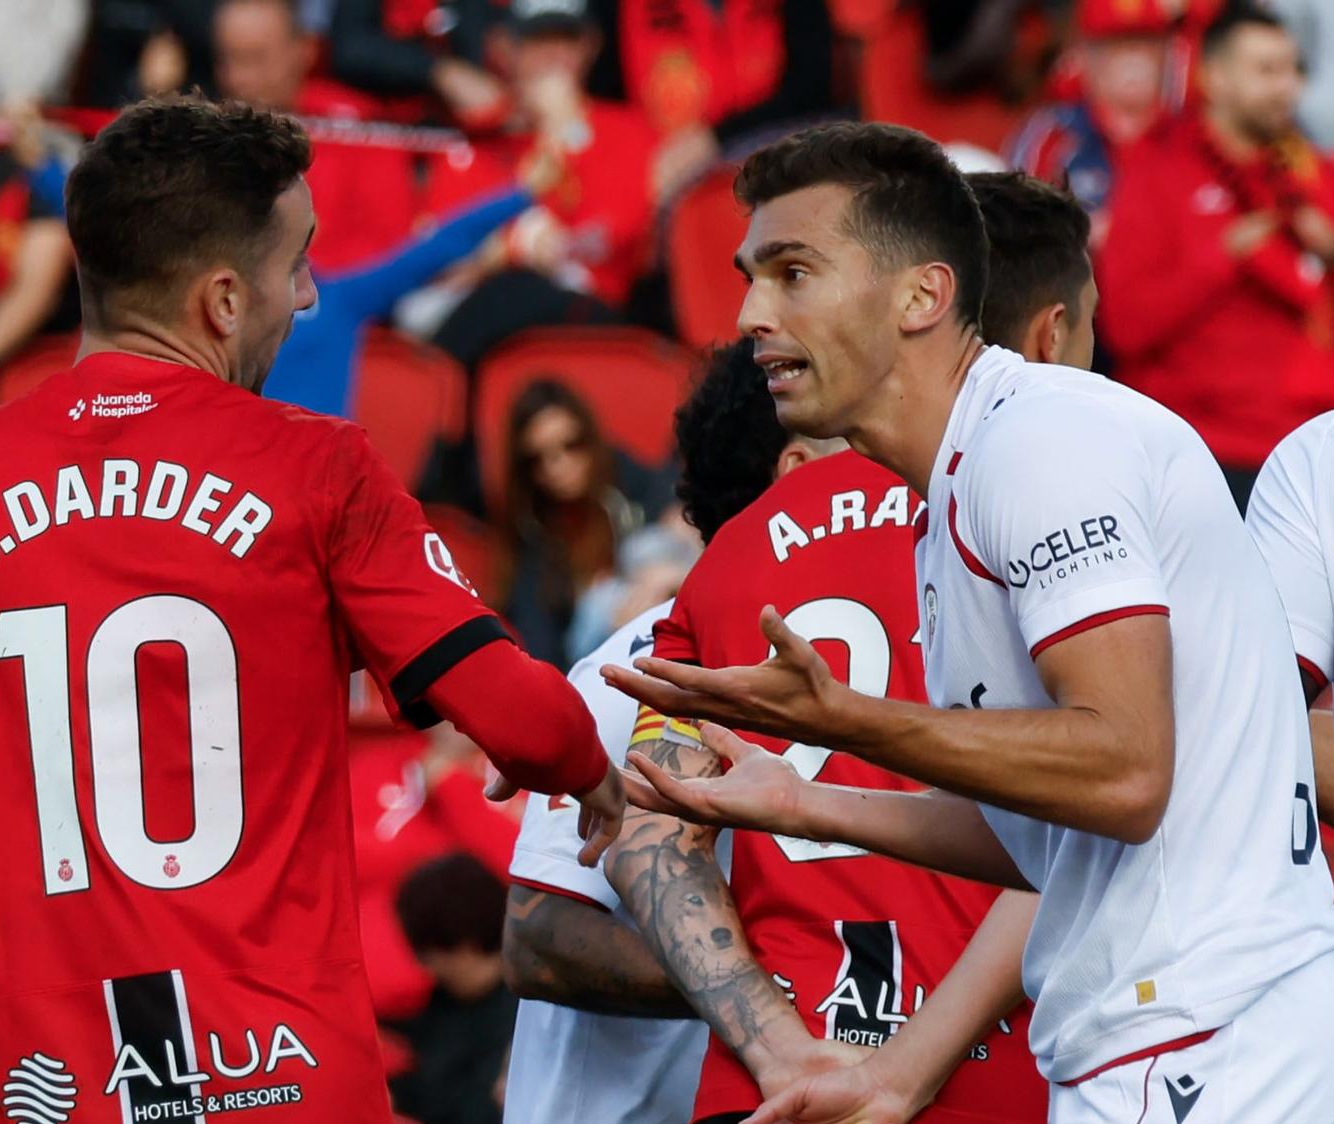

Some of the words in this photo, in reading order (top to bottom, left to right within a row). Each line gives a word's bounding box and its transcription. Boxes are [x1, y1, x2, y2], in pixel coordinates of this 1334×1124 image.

[92, 391, 152, 405] Juaneda
[768, 485, 929, 563] A.RA
[1039, 547, 1128, 590] LIGHTING
[104, 1023, 319, 1095] ALUA
[134, 1096, 204, 1122] HOTELS
[207, 1093, 222, 1112] &
[223, 1084, 302, 1111] RESORTS
